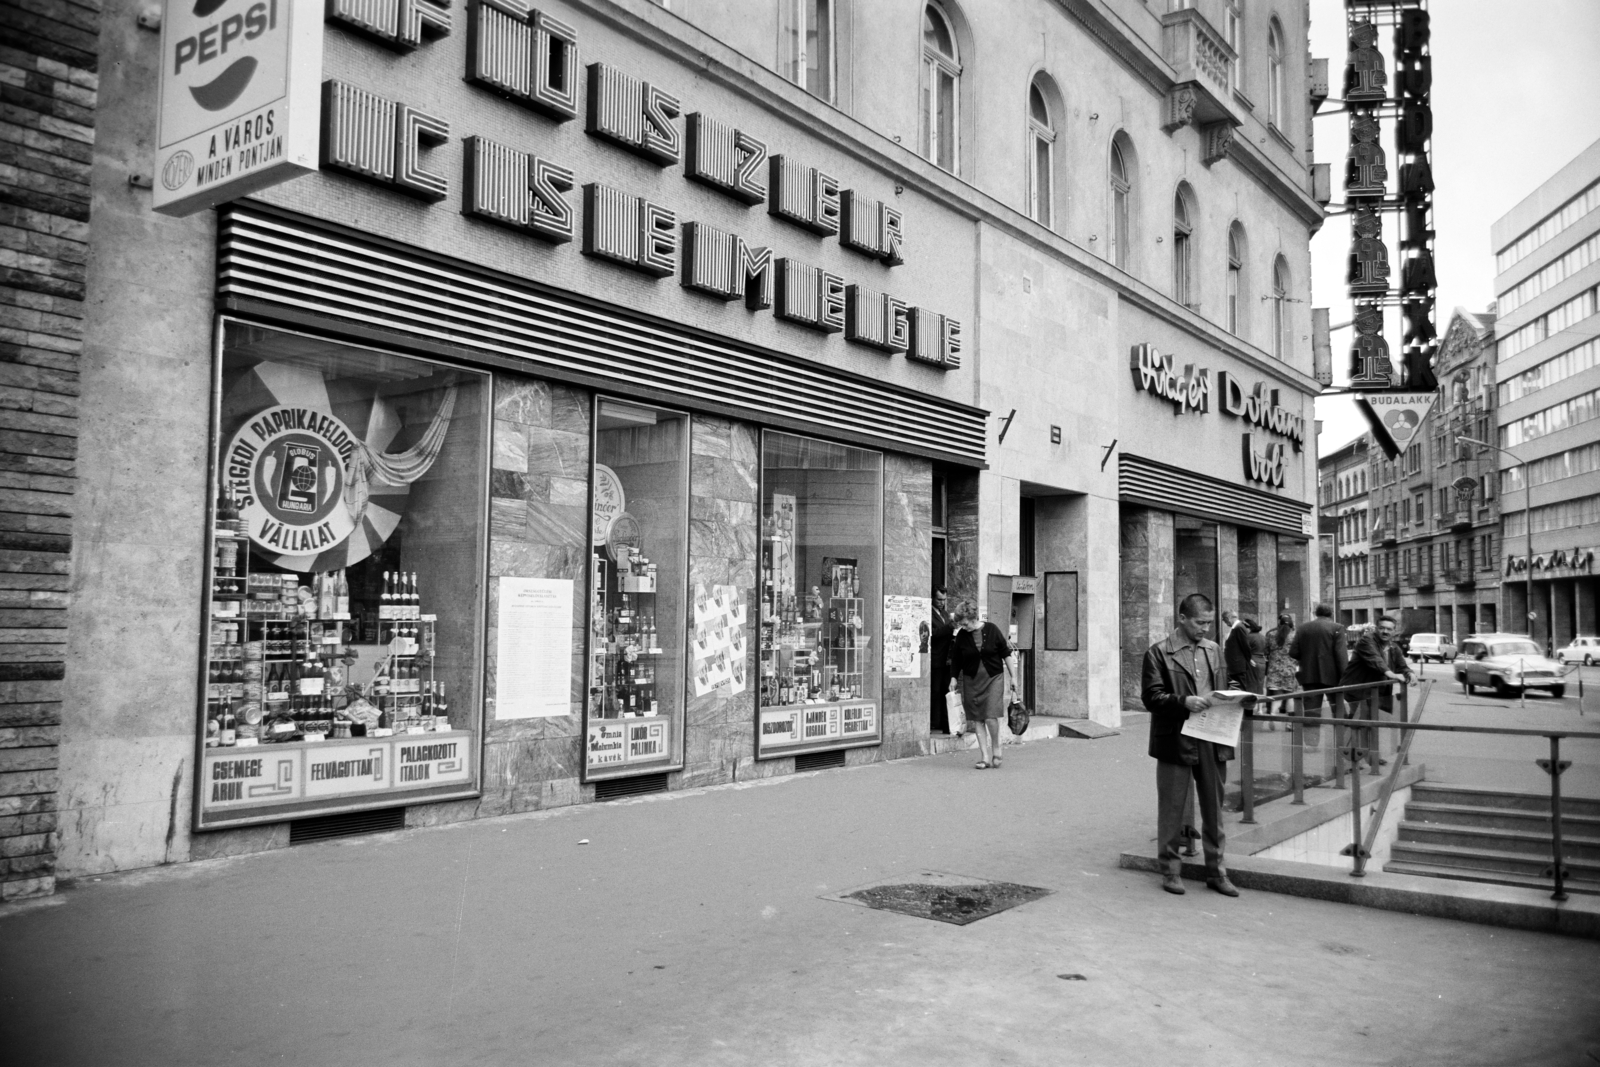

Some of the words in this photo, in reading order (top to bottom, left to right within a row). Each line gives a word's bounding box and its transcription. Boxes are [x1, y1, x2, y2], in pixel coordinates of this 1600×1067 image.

[174, 0, 277, 76] PEPSI
[208, 134, 216, 159] A
[225, 109, 275, 153] VÁROS
[197, 155, 233, 187] MINDEN
[239, 132, 283, 172] PONTJÁN
[319, 79, 961, 371] CSEMEGE
[1371, 395, 1432, 405] BUDALAKK
[289, 448, 316, 460] GLOBUS
[259, 518, 337, 552] VÁLLALAT
[400, 742, 458, 763] PALACKOZOTT
[212, 758, 263, 781] CSEMEGE
[310, 757, 374, 782] FELVÁGOTTAK
[399, 763, 430, 782] ITALOK
[211, 781, 243, 802] ÁRUK
